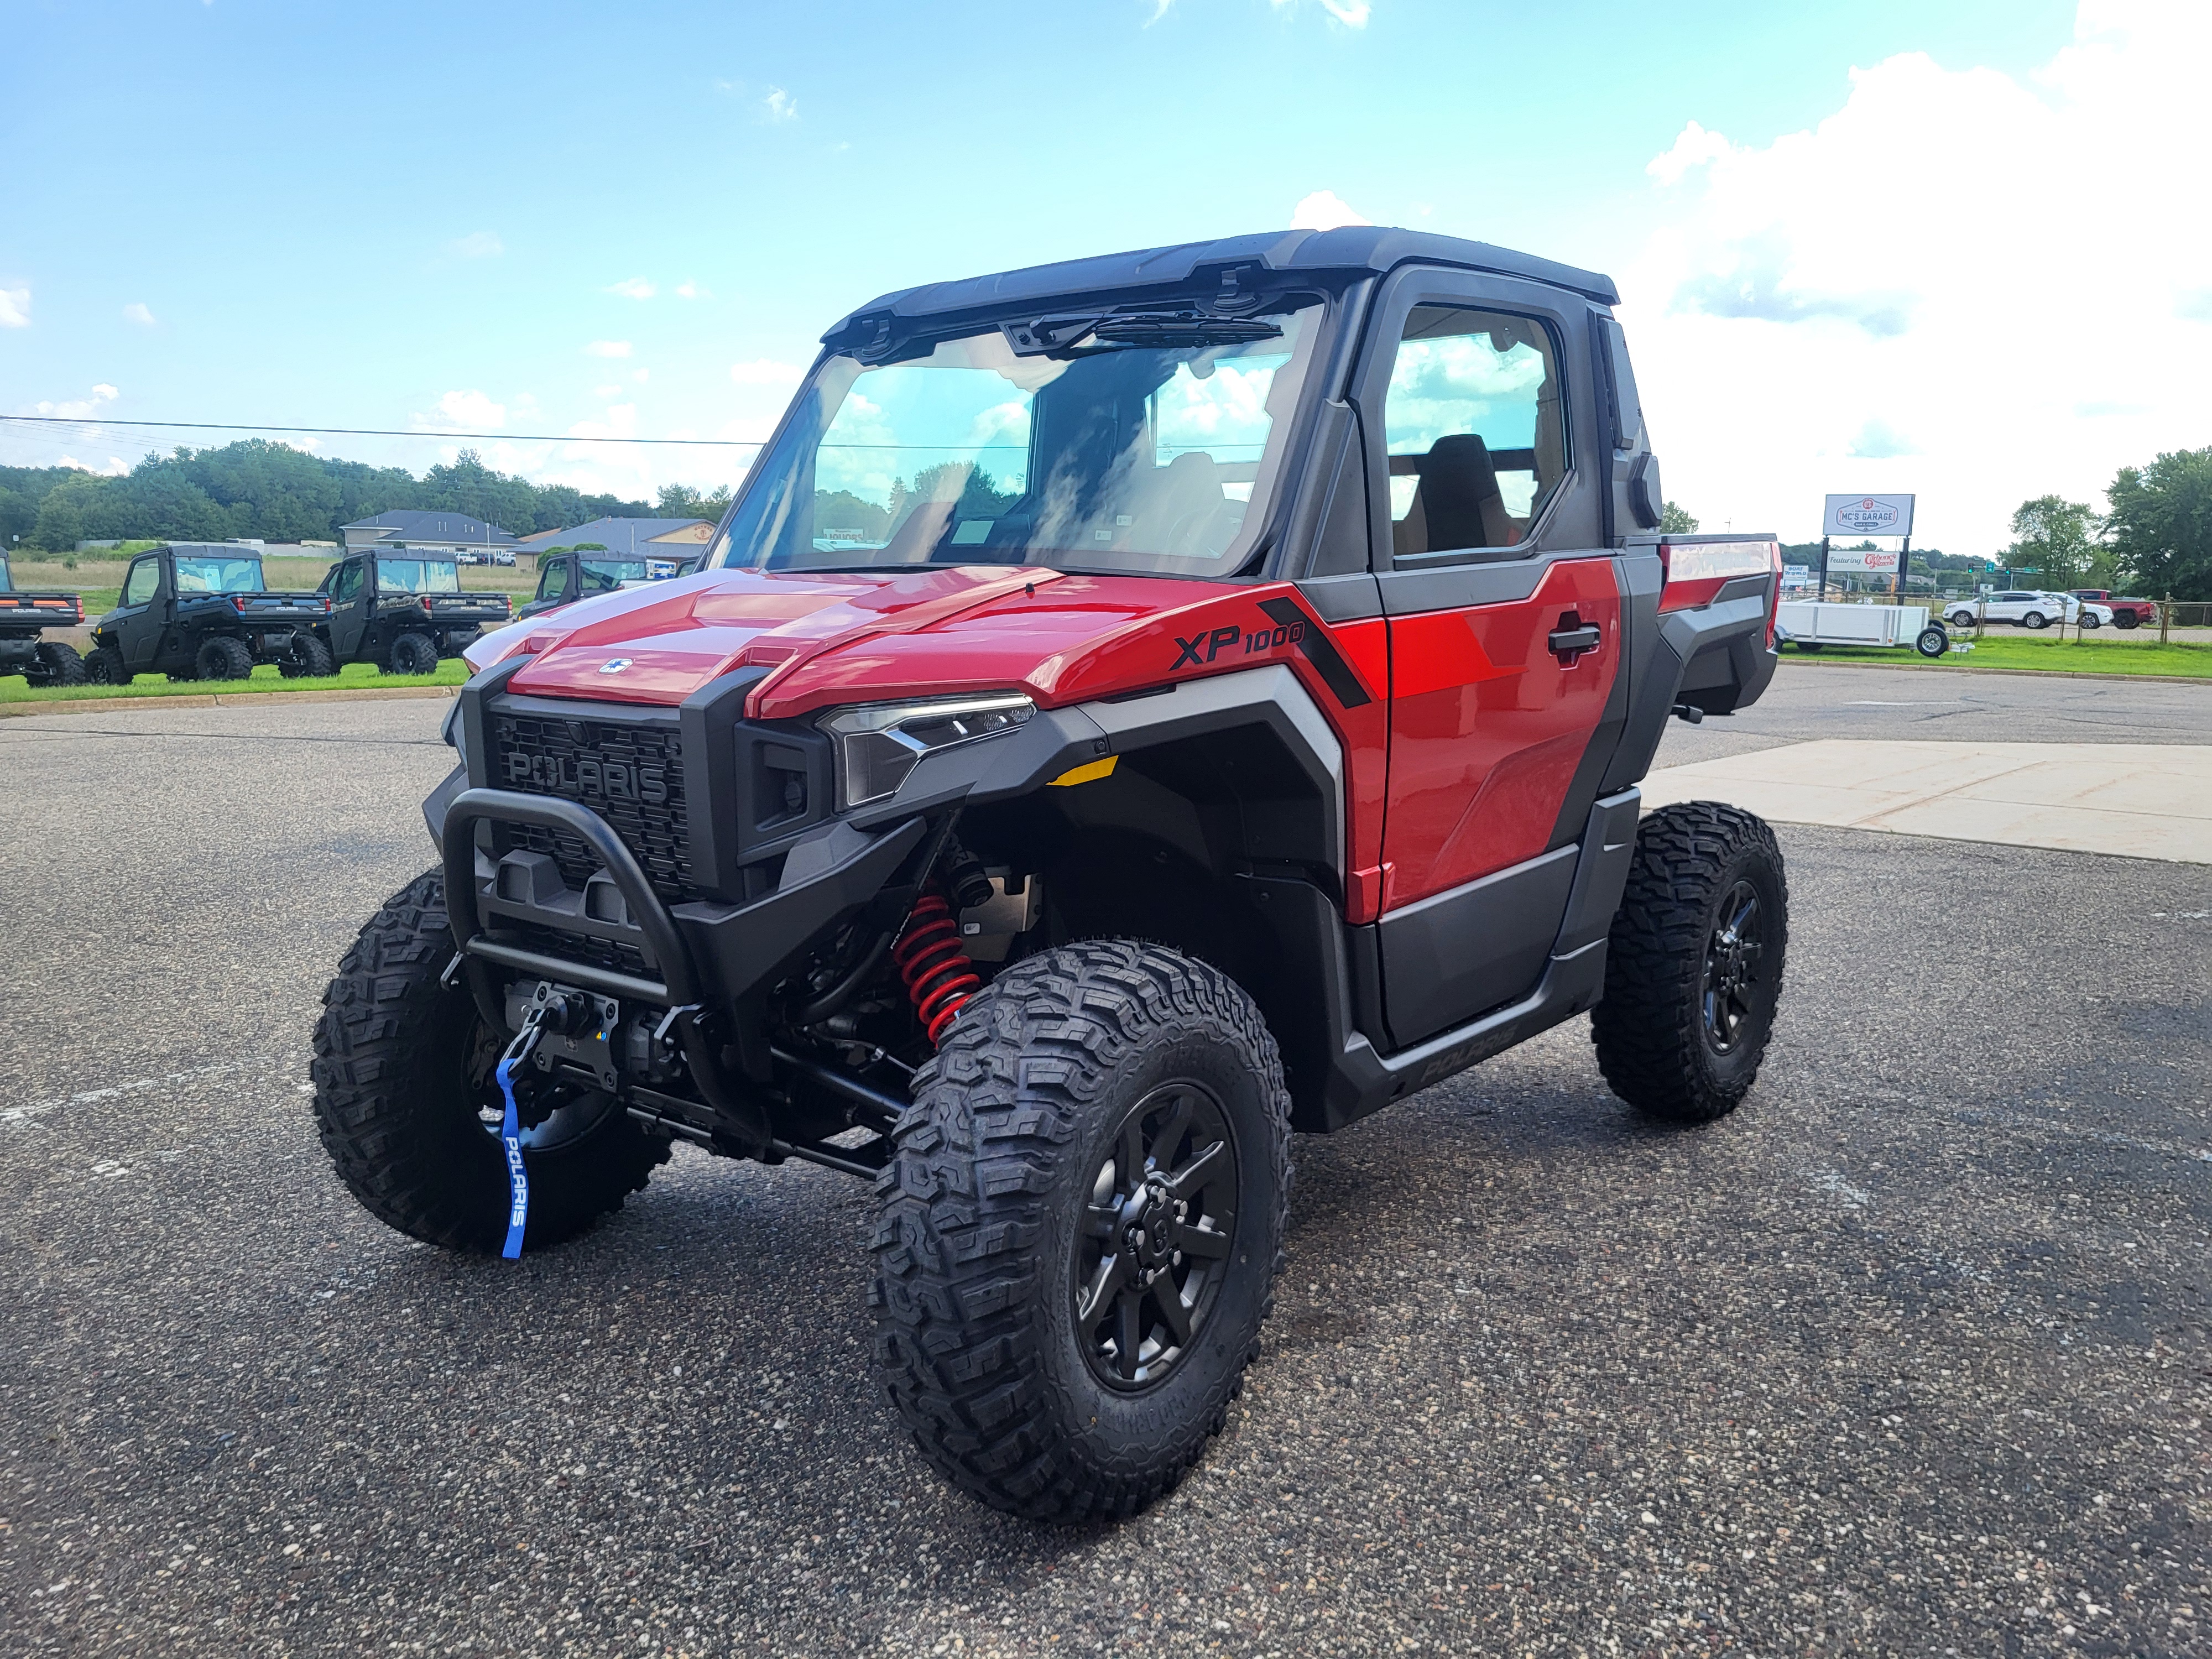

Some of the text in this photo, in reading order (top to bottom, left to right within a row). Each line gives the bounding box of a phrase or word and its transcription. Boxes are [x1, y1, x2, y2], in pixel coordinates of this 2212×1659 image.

[1829, 556, 1861, 565] Featuring
[1168, 621, 1306, 671] XP 1000
[508, 752, 667, 801] POLARIS
[1420, 1023, 1519, 1083] POLARIS
[505, 1136, 528, 1227] POLARIS
